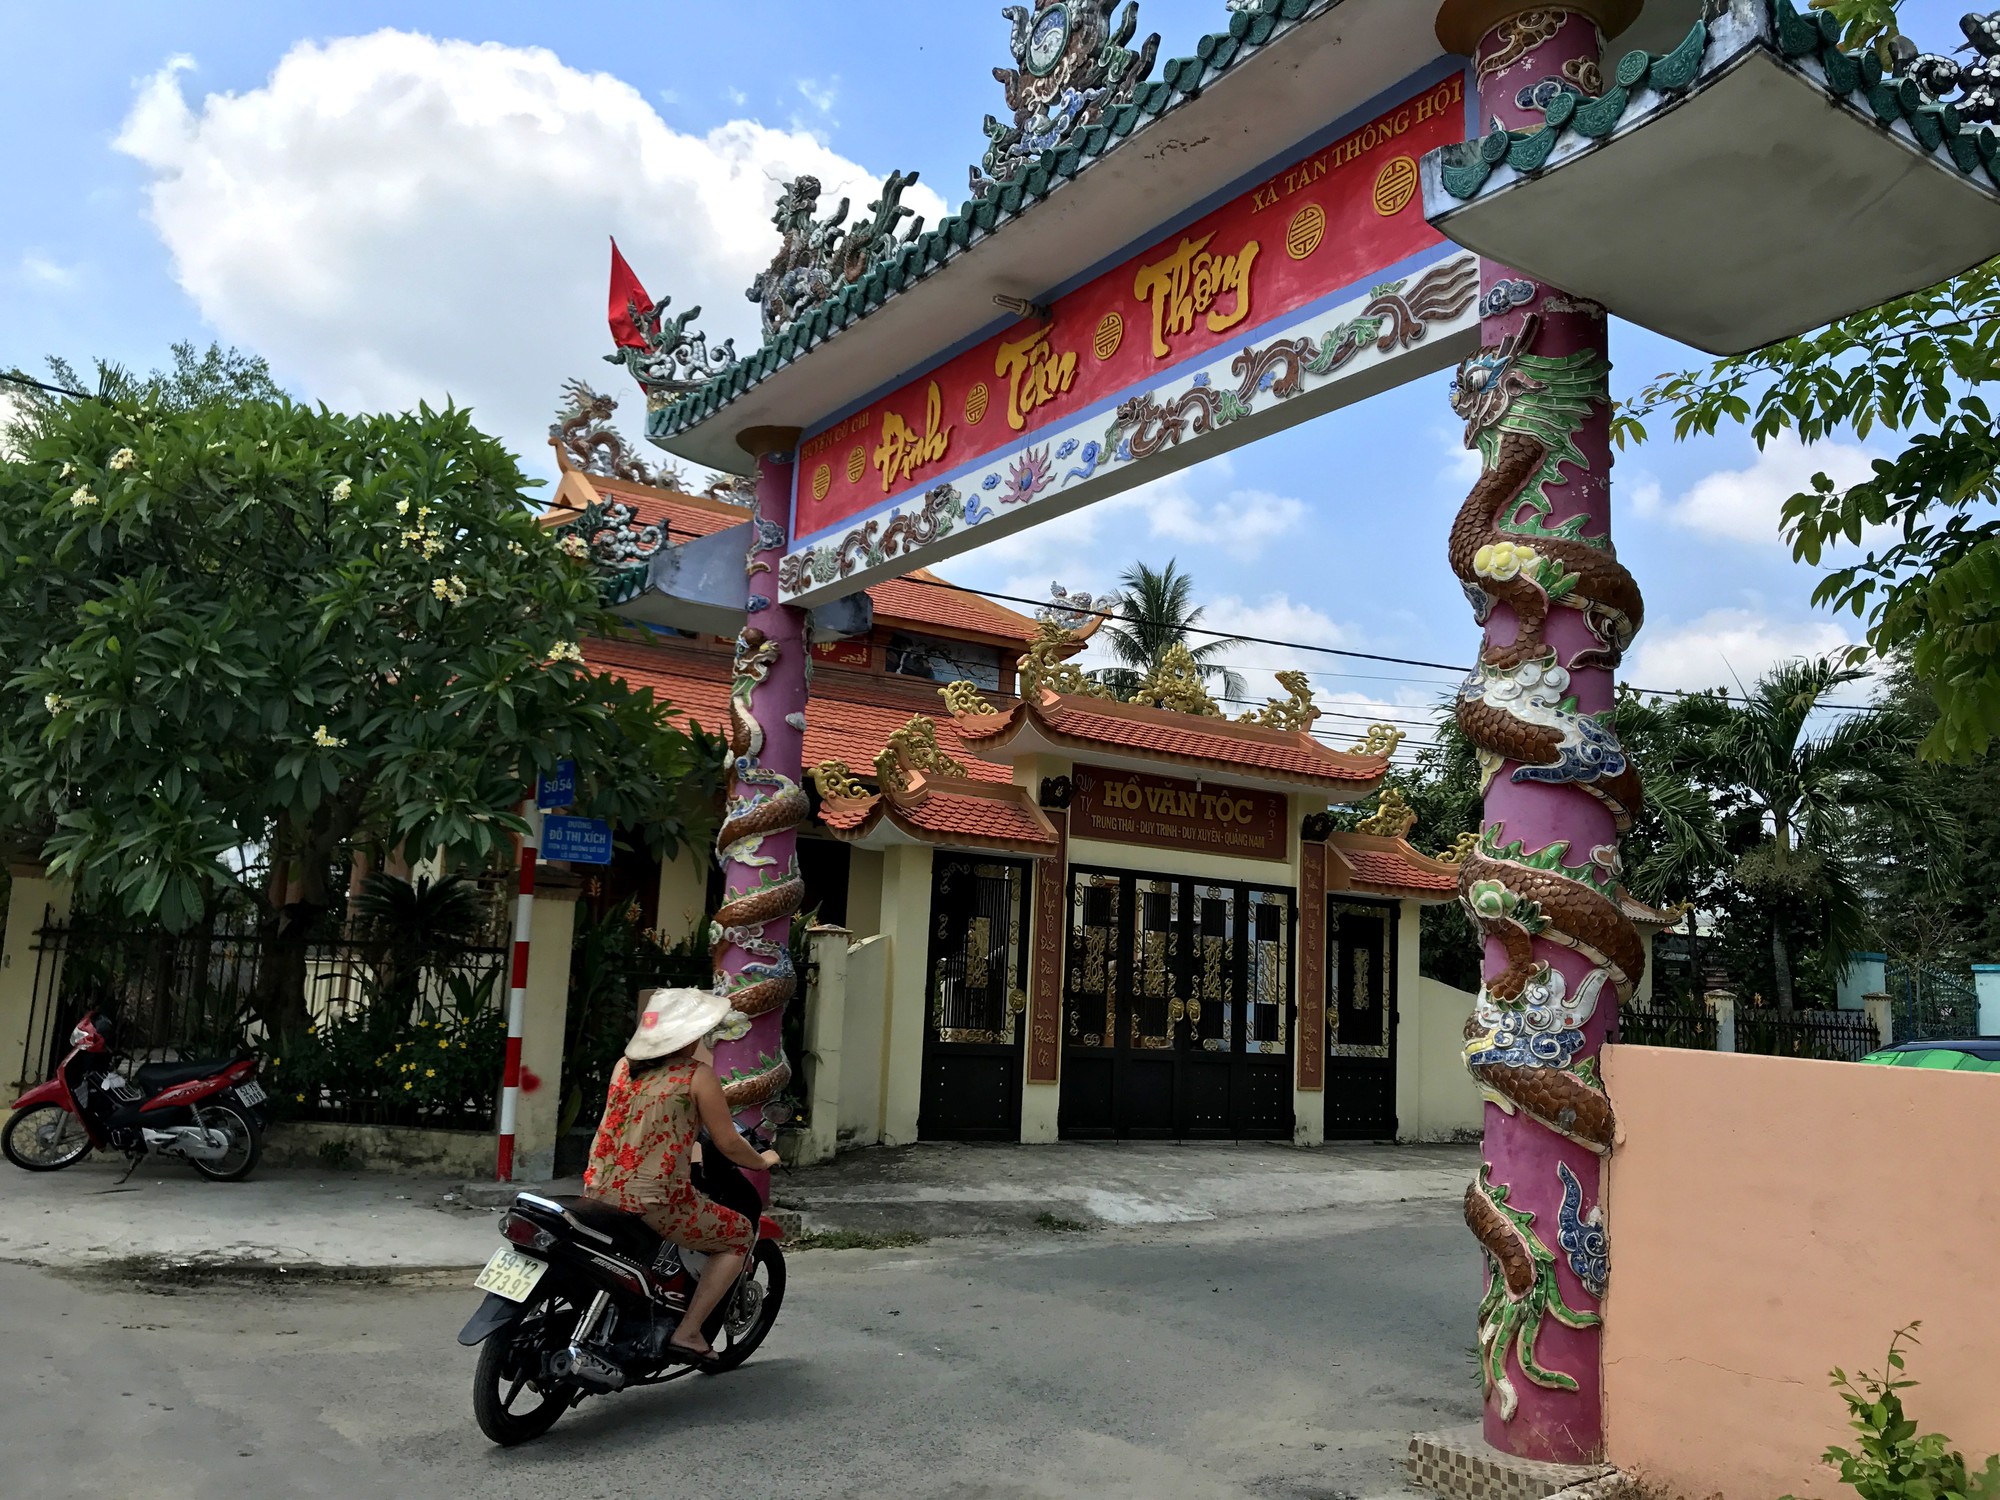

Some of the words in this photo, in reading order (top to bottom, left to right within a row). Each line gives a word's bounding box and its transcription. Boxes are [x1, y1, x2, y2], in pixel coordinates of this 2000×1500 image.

[1251, 176, 1281, 214] XÃ
[1284, 161, 1328, 195] TÂN
[1331, 108, 1411, 168] THÔNG
[1415, 80, 1463, 124] HỘI
[1103, 775, 1142, 811] HỒ
[1145, 780, 1198, 818] VĂN
[1200, 789, 1254, 828] TỘC
[583, 831, 606, 844] XÍCH
[1091, 814, 1118, 831] TRUNG
[1139, 820, 1155, 836] DUY
[1156, 822, 1177, 838] TRINH
[1182, 826, 1196, 842] DUY
[1197, 827, 1221, 844] XUYÊN
[1224, 829, 1248, 848] QUẢNG
[1248, 834, 1265, 849] NAM
[497, 1252, 538, 1279] 59-Y2
[480, 1268, 531, 1298] 573.97
